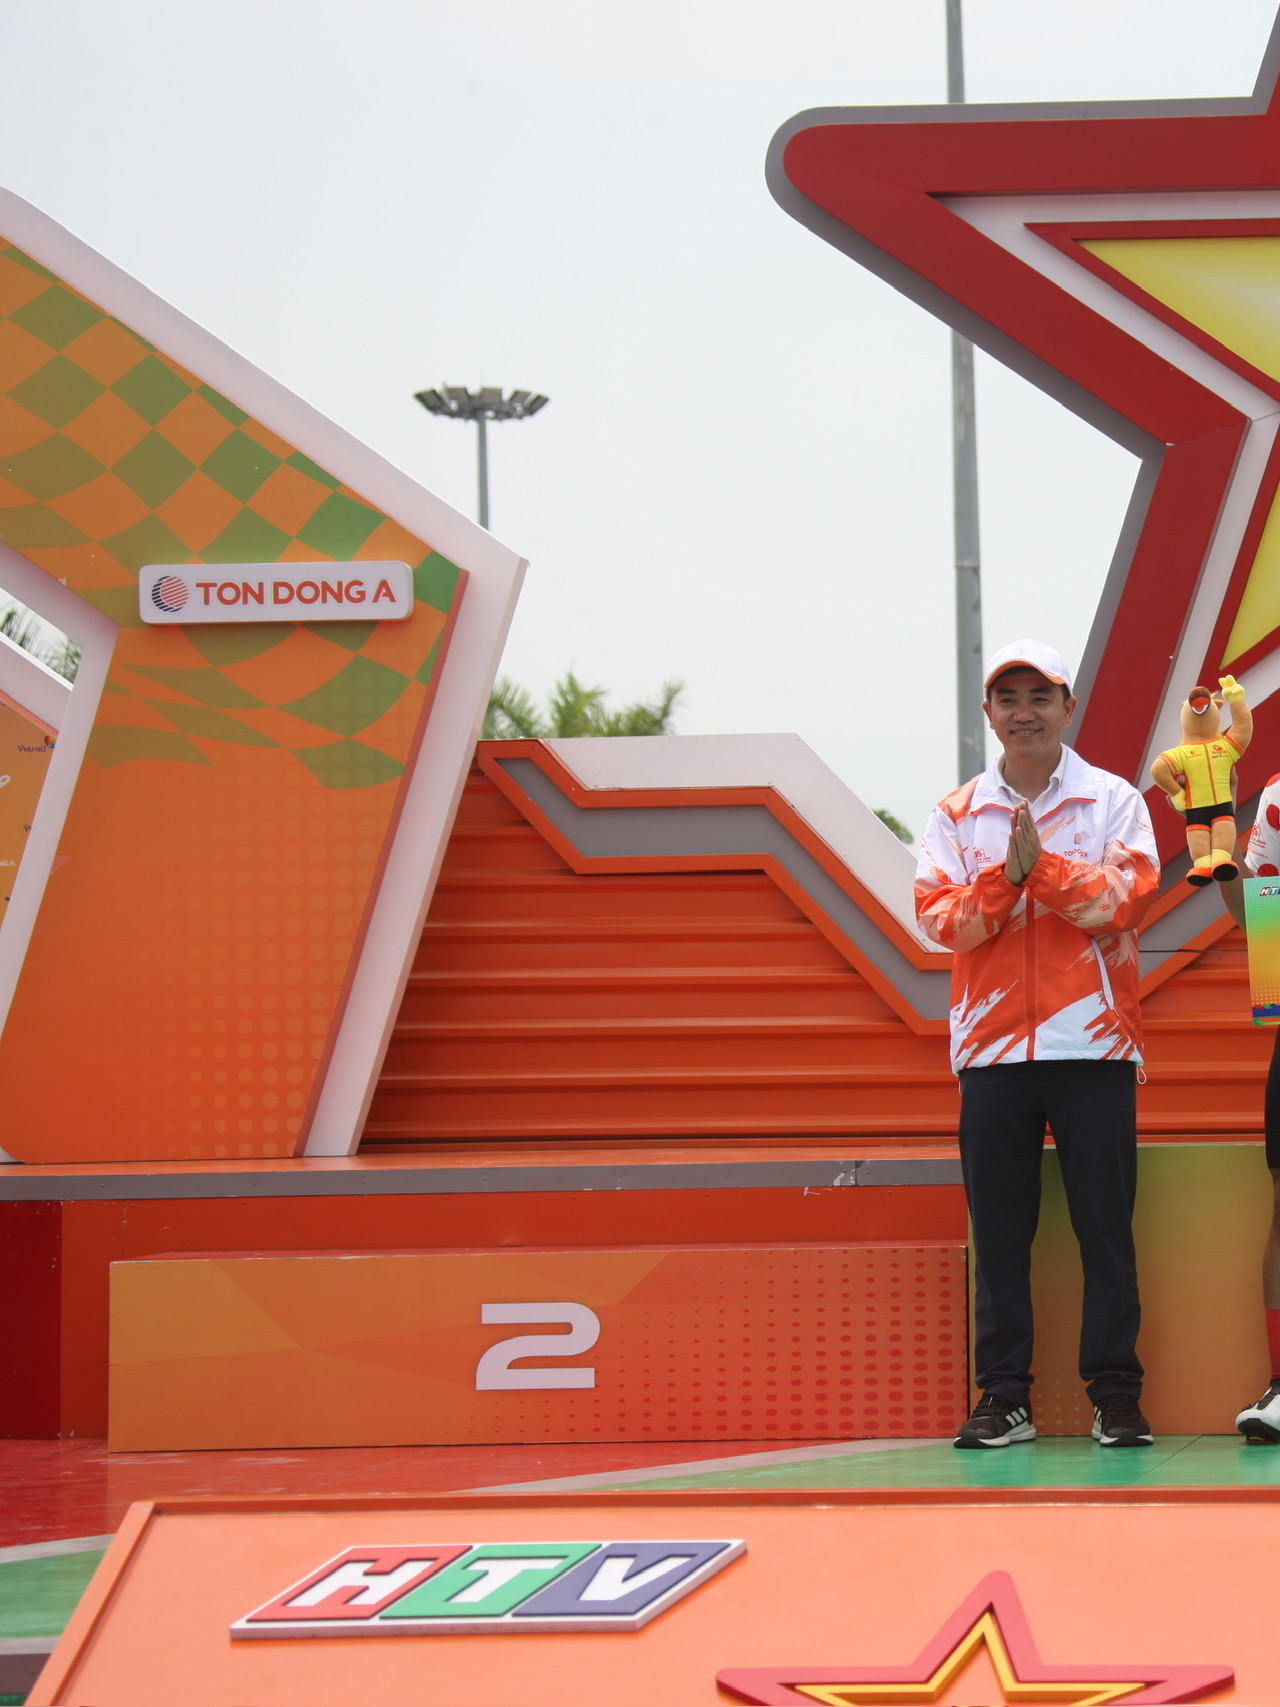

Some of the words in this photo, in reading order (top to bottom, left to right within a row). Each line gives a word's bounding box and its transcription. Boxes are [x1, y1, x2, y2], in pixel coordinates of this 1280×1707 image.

[195, 581, 264, 606] TON
[272, 579, 367, 605] DONG
[371, 578, 397, 604] A
[475, 1301, 600, 1390] 2
[279, 1553, 701, 1608] HTV
